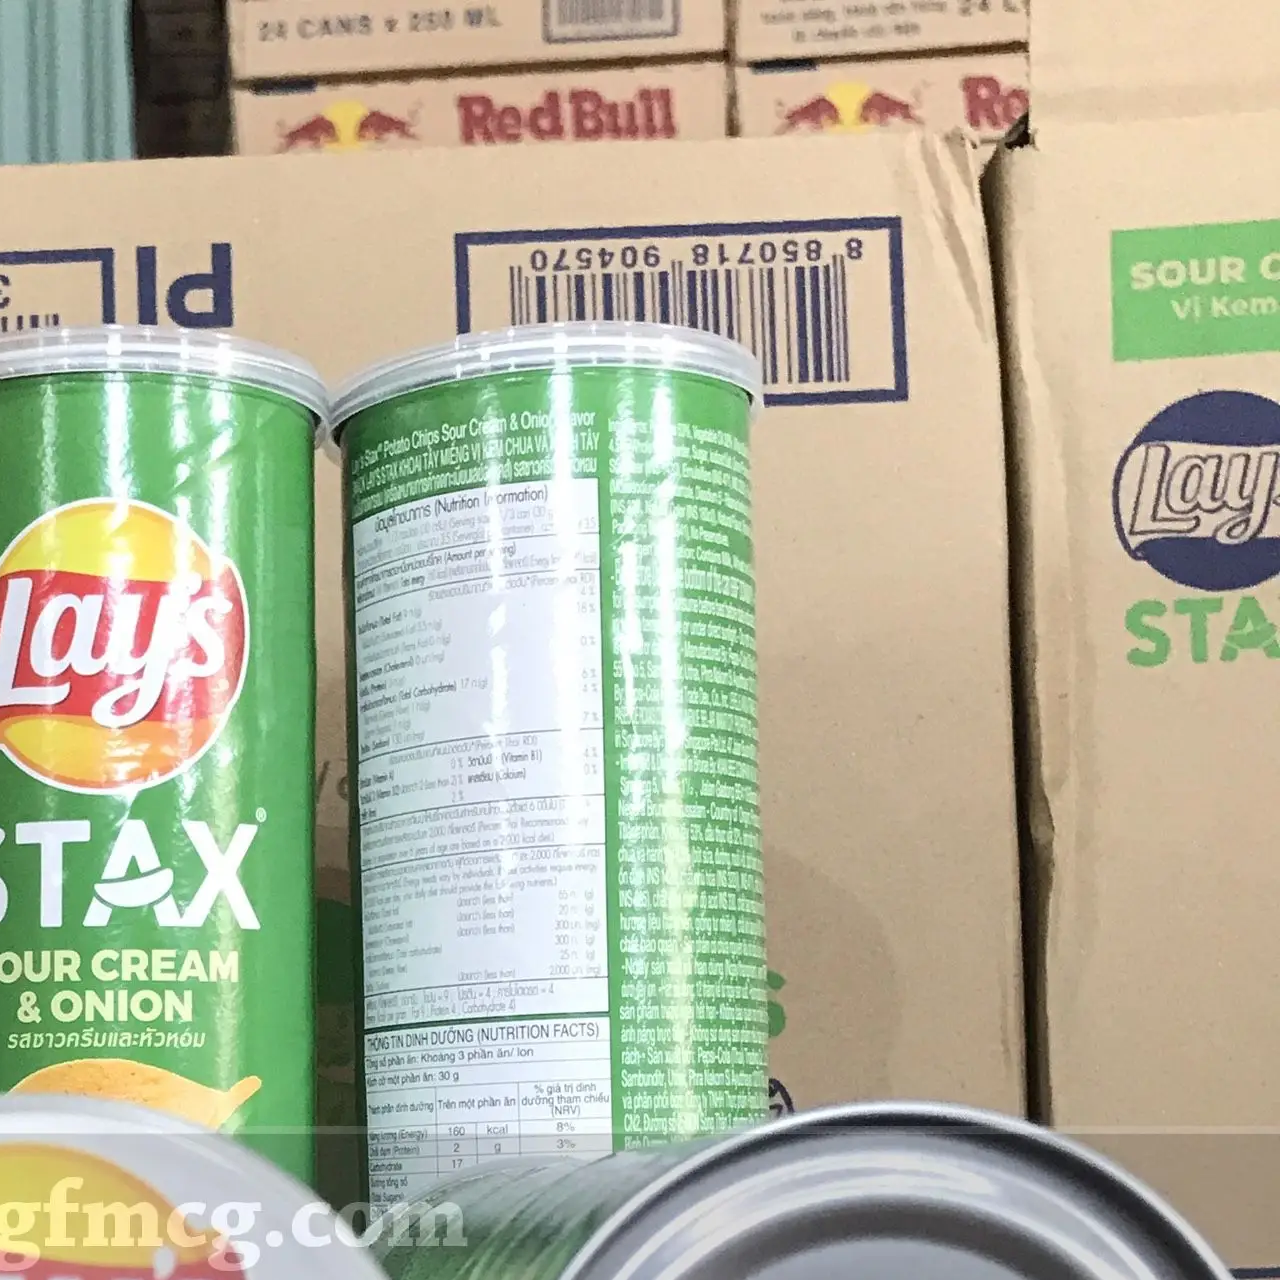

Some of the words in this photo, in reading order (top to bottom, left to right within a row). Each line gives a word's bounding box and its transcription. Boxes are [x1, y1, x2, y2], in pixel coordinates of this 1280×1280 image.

[530, 244, 661, 273] 904570
[691, 240, 823, 268] 850718
[844, 240, 864, 262] 8
[1130, 254, 1246, 291] SOUR
[1211, 296, 1280, 318] Kem
[412, 429, 440, 449] Chips
[442, 423, 467, 441] Sour
[510, 412, 518, 431] &
[520, 410, 556, 430] Onio
[505, 436, 533, 456] CHUA
[1129, 442, 1280, 544] Lay
[1124, 595, 1280, 667] STA
[91, 949, 239, 983] CREAM
[16, 992, 42, 1025] &
[51, 989, 193, 1023] ONION
[477, 1024, 549, 1043] (NUTRITION
[554, 1022, 599, 1041] FACTS)
[467, 1048, 493, 1062] phần
[517, 1047, 534, 1057] lon
[438, 1071, 450, 1081] 30
[534, 1084, 544, 1094] %
[576, 1082, 597, 1093] dinh
[438, 1099, 457, 1110] Trên
[458, 1098, 475, 1110] một
[477, 1096, 501, 1108] phần
[557, 1095, 582, 1105] tham
[551, 1105, 581, 1118] (NRV)
[448, 1126, 466, 1137] 160
[486, 1124, 509, 1135] kcal
[556, 1122, 576, 1133] 8%
[556, 1139, 576, 1150] 3%
[451, 1159, 464, 1169] 17
